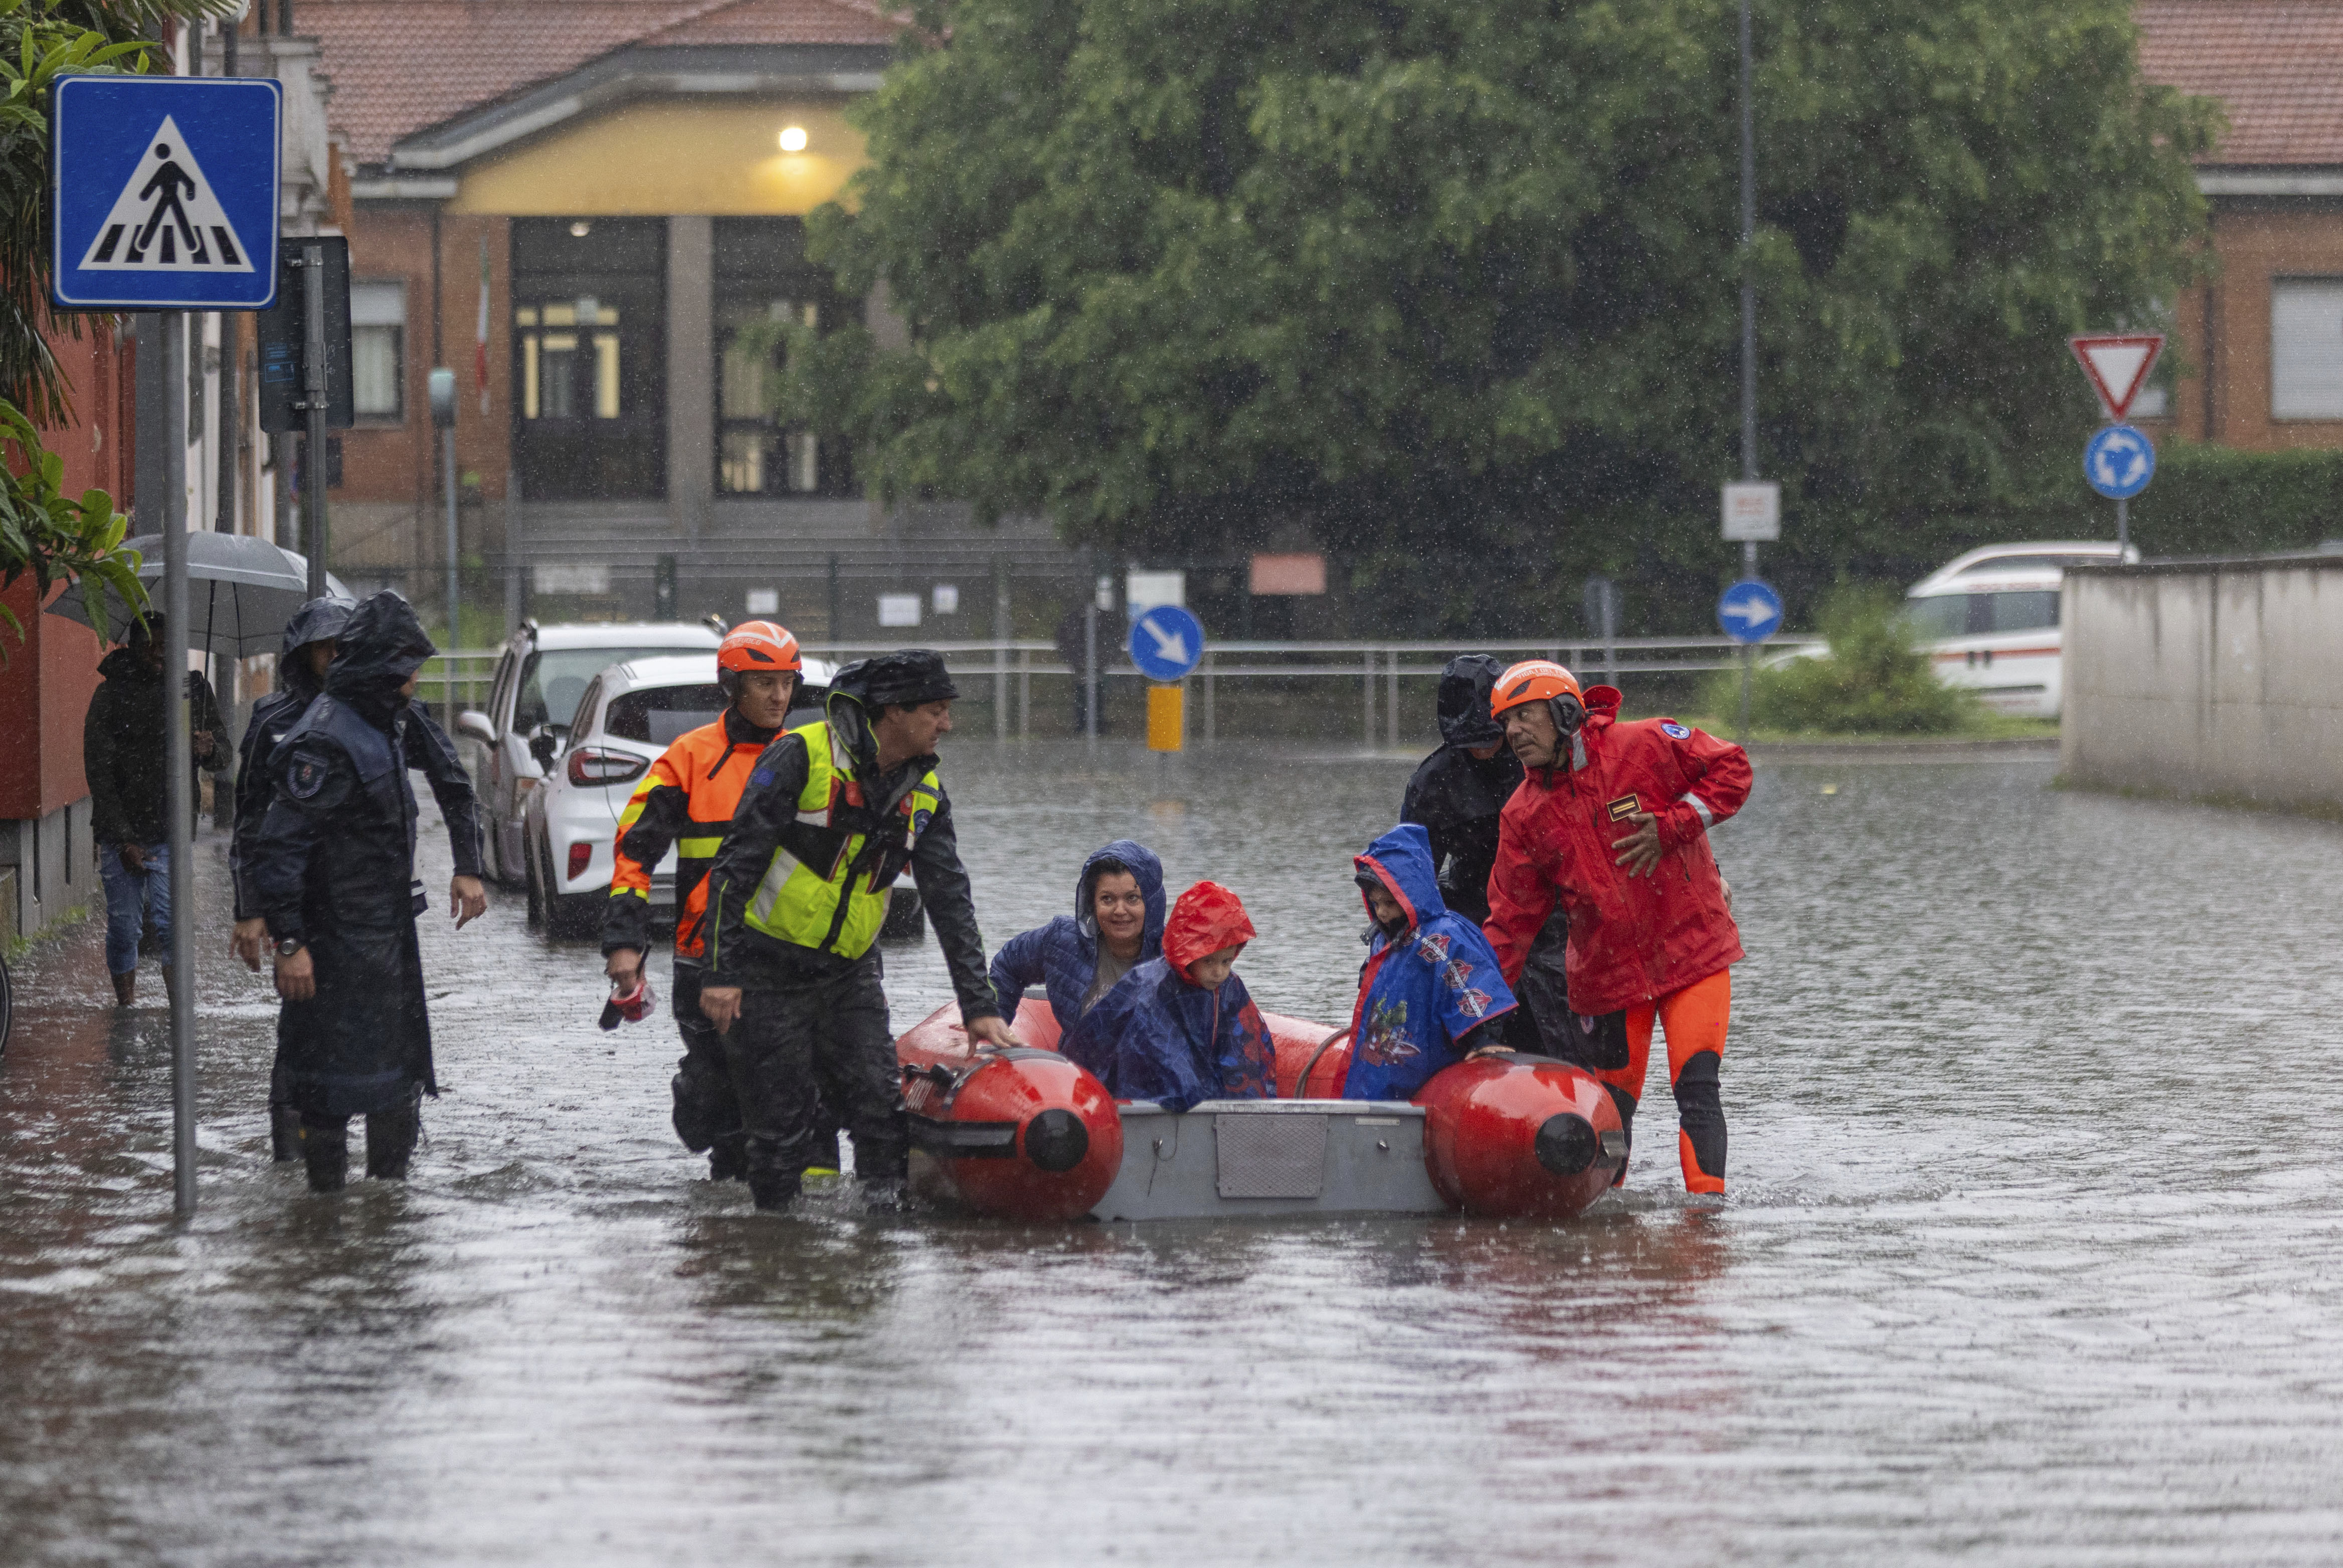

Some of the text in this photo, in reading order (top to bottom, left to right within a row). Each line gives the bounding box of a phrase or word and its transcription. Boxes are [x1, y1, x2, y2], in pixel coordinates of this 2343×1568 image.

[738, 638, 762, 646] FUOCO
[1420, 937, 1448, 961] AVENGERS
[1463, 990, 1484, 1018] AVENGERS
